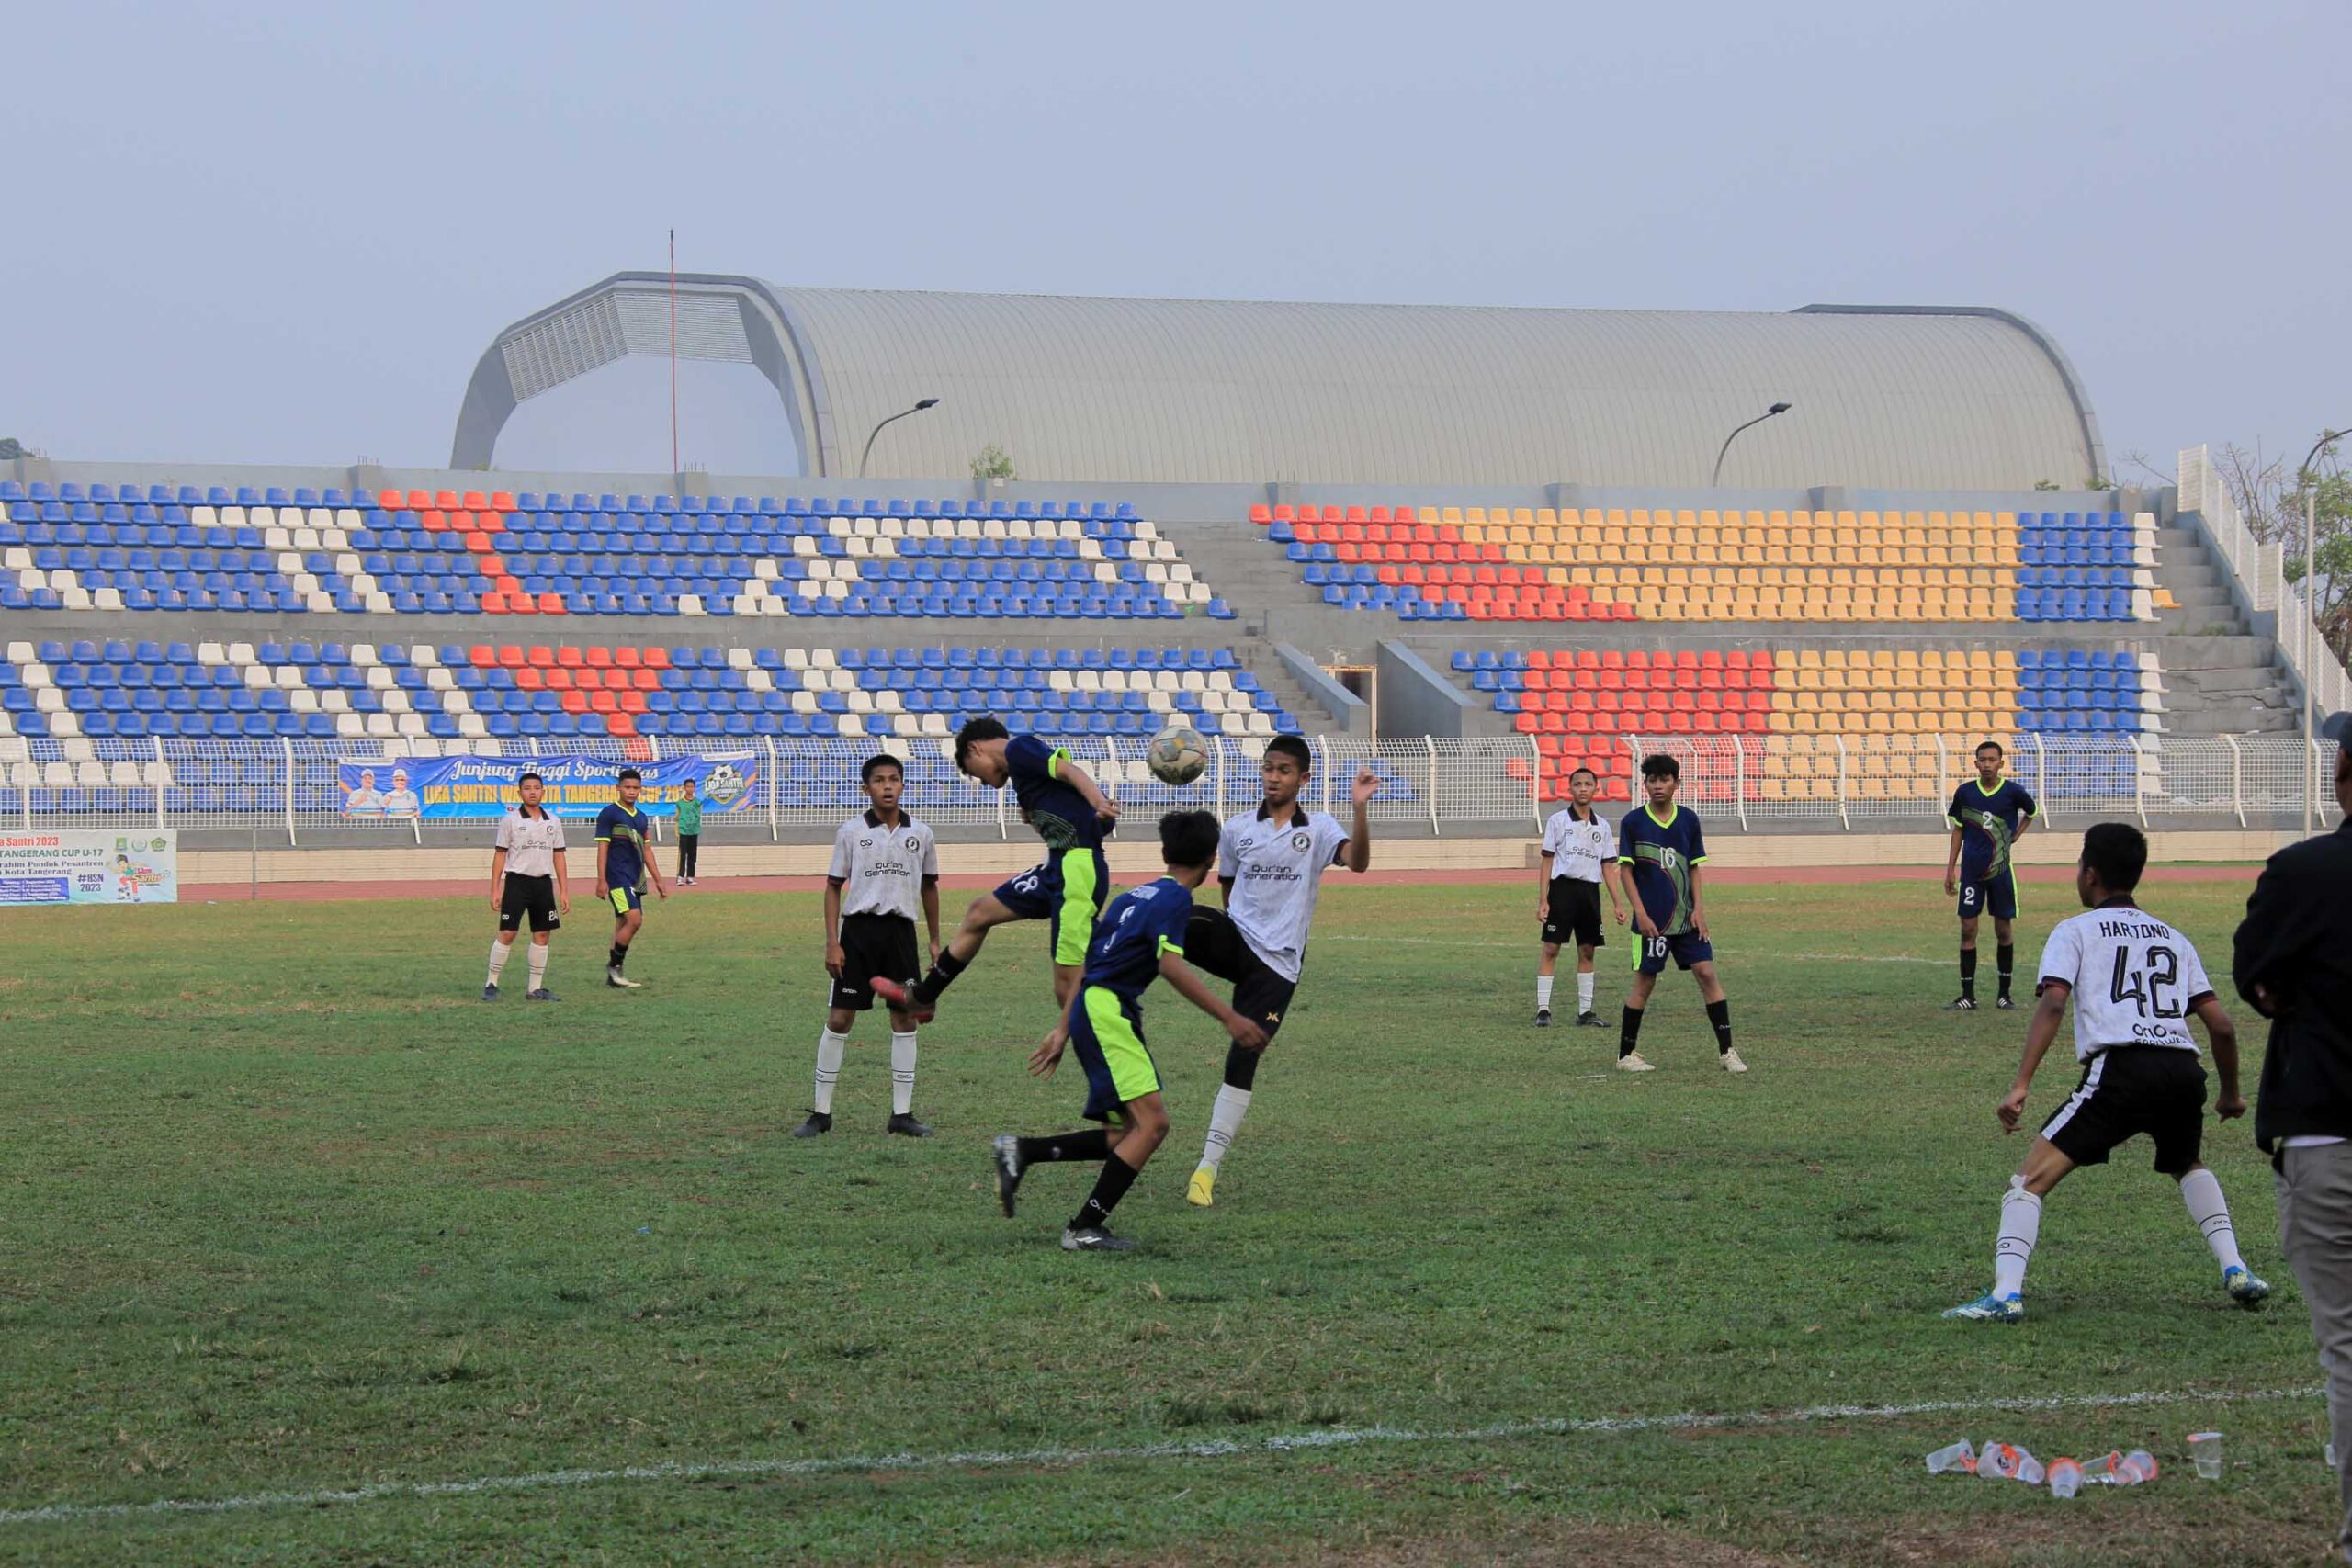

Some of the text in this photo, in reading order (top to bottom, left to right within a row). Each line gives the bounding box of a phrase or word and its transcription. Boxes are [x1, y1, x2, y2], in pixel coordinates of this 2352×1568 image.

[451, 761, 517, 781] Junjung
[452, 784, 497, 803] SANTRI
[1982, 811, 1993, 829] 2
[6, 837, 35, 846] Santri
[36, 837, 59, 846] 2023
[62, 849, 81, 857] CUP
[1659, 847, 1677, 869] 16
[80, 883, 102, 892] 2023
[1963, 886, 1975, 906] 2
[2099, 920, 2170, 940] HARTONO
[1647, 936, 1668, 958] 16
[2110, 945, 2183, 1019] 42
